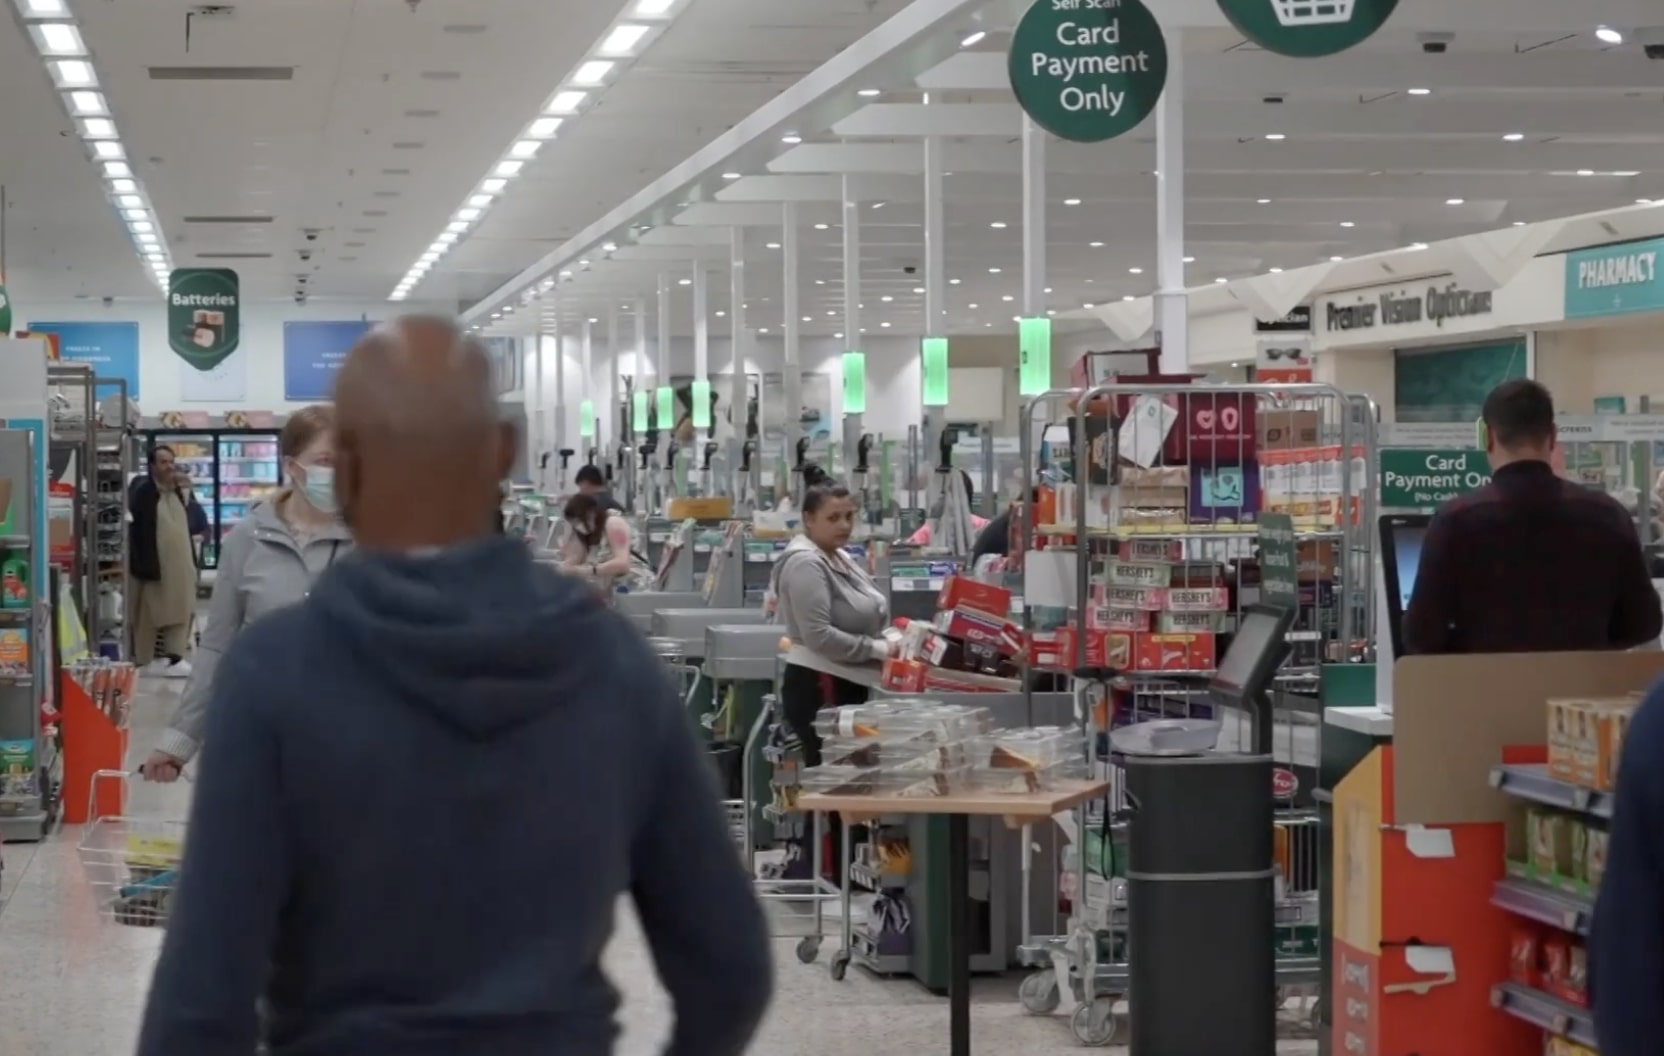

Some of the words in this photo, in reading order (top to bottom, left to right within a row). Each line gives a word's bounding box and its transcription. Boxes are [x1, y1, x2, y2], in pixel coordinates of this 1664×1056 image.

[1056, 18, 1120, 46] Card
[1031, 51, 1149, 82] Payment
[1060, 83, 1126, 117] Only
[1578, 251, 1657, 289] PHARMACY
[171, 292, 237, 307] Batteries
[1326, 295, 1377, 331] Premier
[1379, 291, 1422, 325] Vision
[1425, 453, 1467, 471] Card
[1385, 471, 1462, 492] Payment
